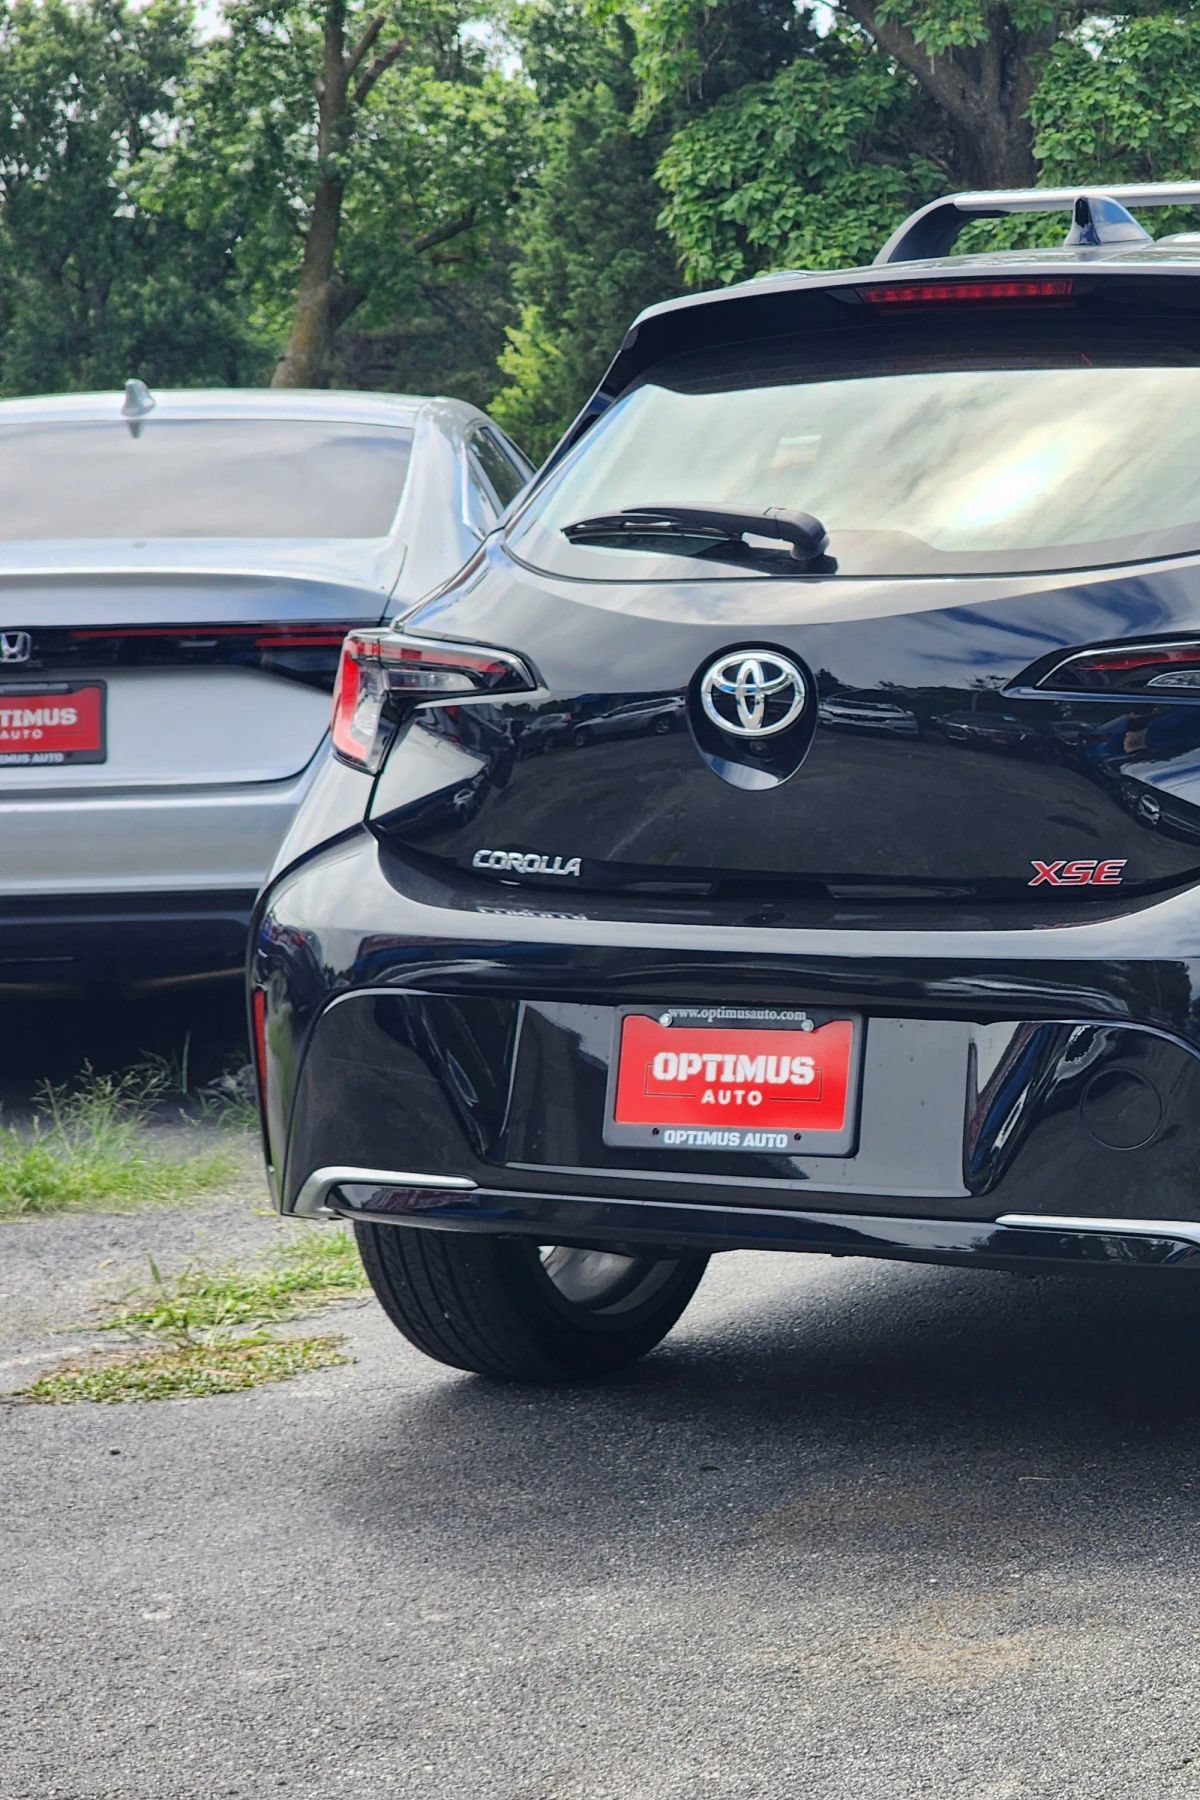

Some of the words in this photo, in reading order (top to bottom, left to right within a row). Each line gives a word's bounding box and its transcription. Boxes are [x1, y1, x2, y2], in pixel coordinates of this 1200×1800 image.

[0, 728, 43, 740] AUTO
[31, 752, 64, 763] AUTO
[472, 850, 582, 876] COROLLA
[1027, 859, 1128, 885] XSE
[668, 1006, 806, 1022] www.optimusauto.com
[653, 1052, 815, 1085] OPTIMUS
[701, 1089, 763, 1105] AUTO
[664, 1130, 740, 1147] OPTIMUS
[743, 1132, 788, 1148] AUTO
